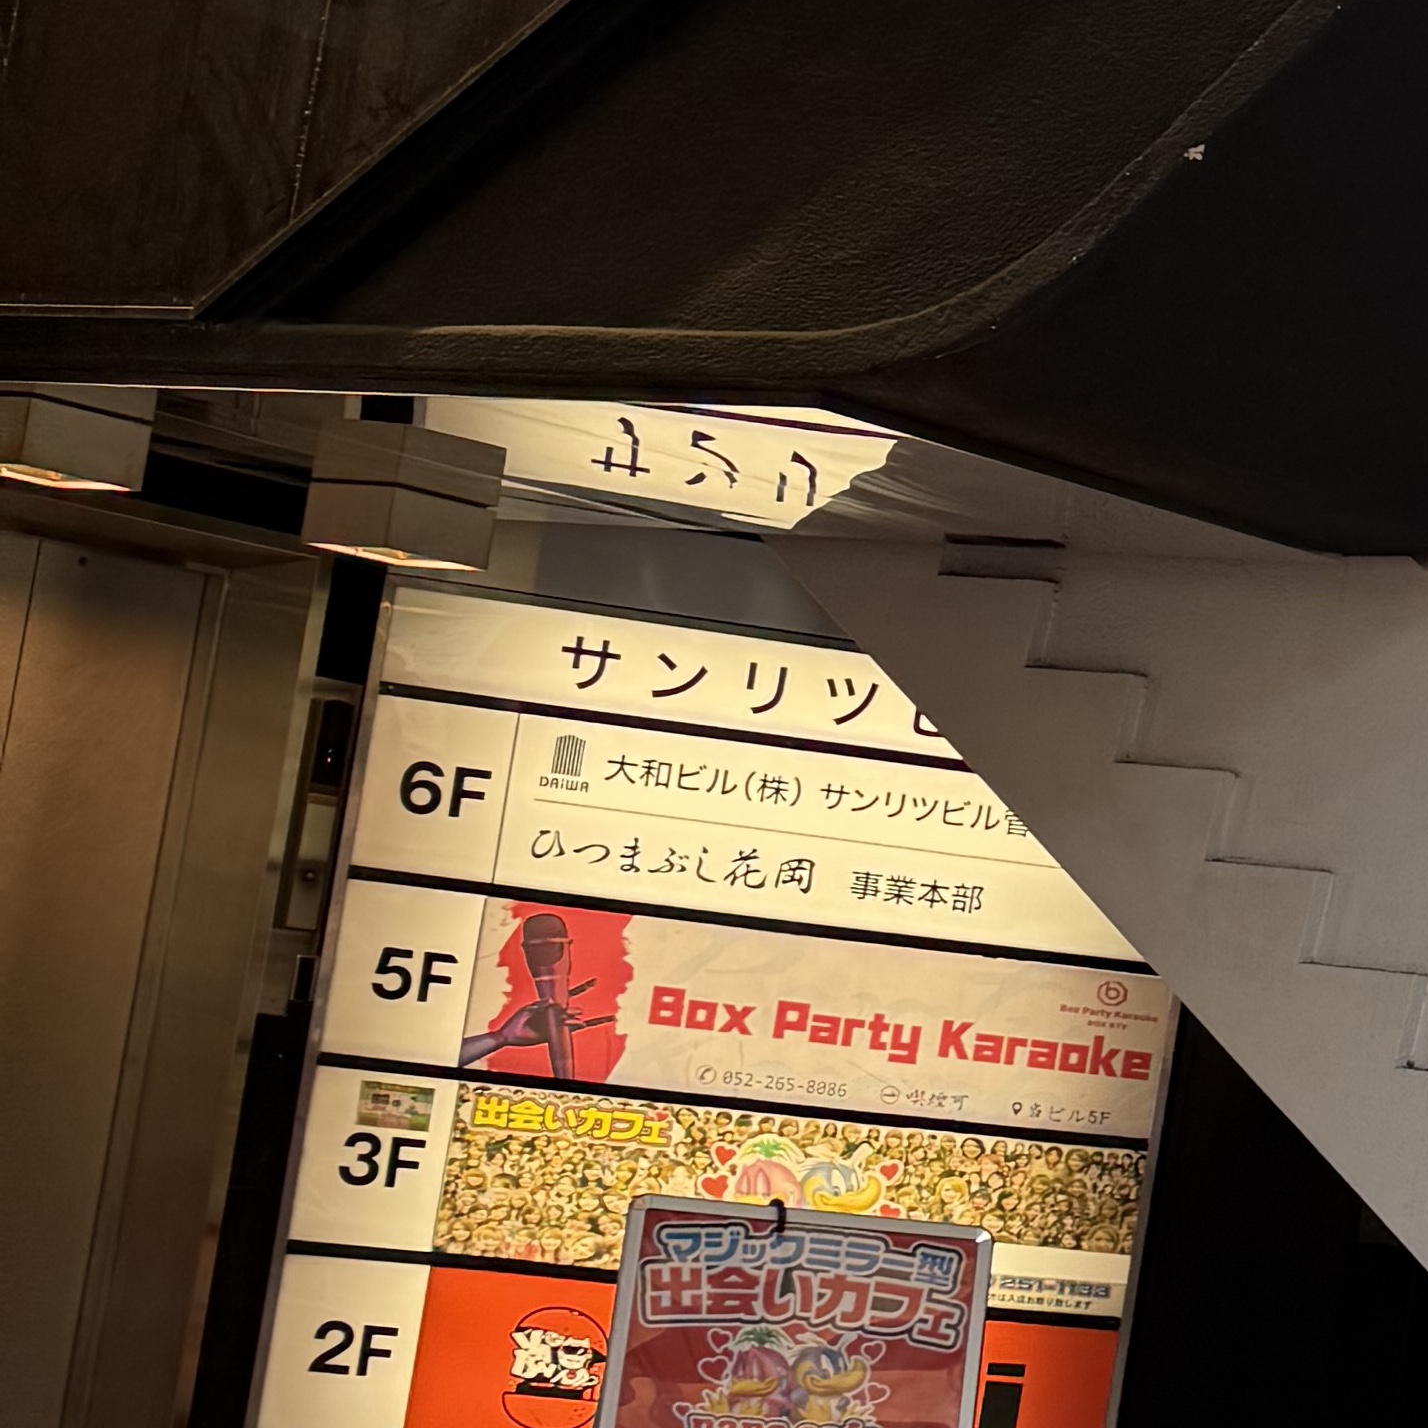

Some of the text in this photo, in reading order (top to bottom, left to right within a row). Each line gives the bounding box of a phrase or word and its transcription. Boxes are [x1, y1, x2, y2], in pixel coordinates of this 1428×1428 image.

[561, 635, 943, 737] サンリツ
[400, 760, 493, 819] 6F
[603, 754, 801, 809] 大和ビル(株)
[530, 828, 985, 915] ひつまぶし花岡 事業本部
[371, 947, 459, 1005] 5F
[648, 985, 1154, 1081] Box Party Karaoke
[1060, 1003, 1159, 1023] Box Party Karaoke
[723, 1069, 848, 1098] 052-265-8086
[906, 1089, 970, 1111] 喫煙可
[473, 1096, 674, 1146] 出会いカフェ
[338, 1132, 426, 1188] 3F
[664, 1230, 957, 1287] マジックミラー型
[650, 1265, 958, 1343] 出会いカフェ
[308, 1320, 399, 1376] 2F
